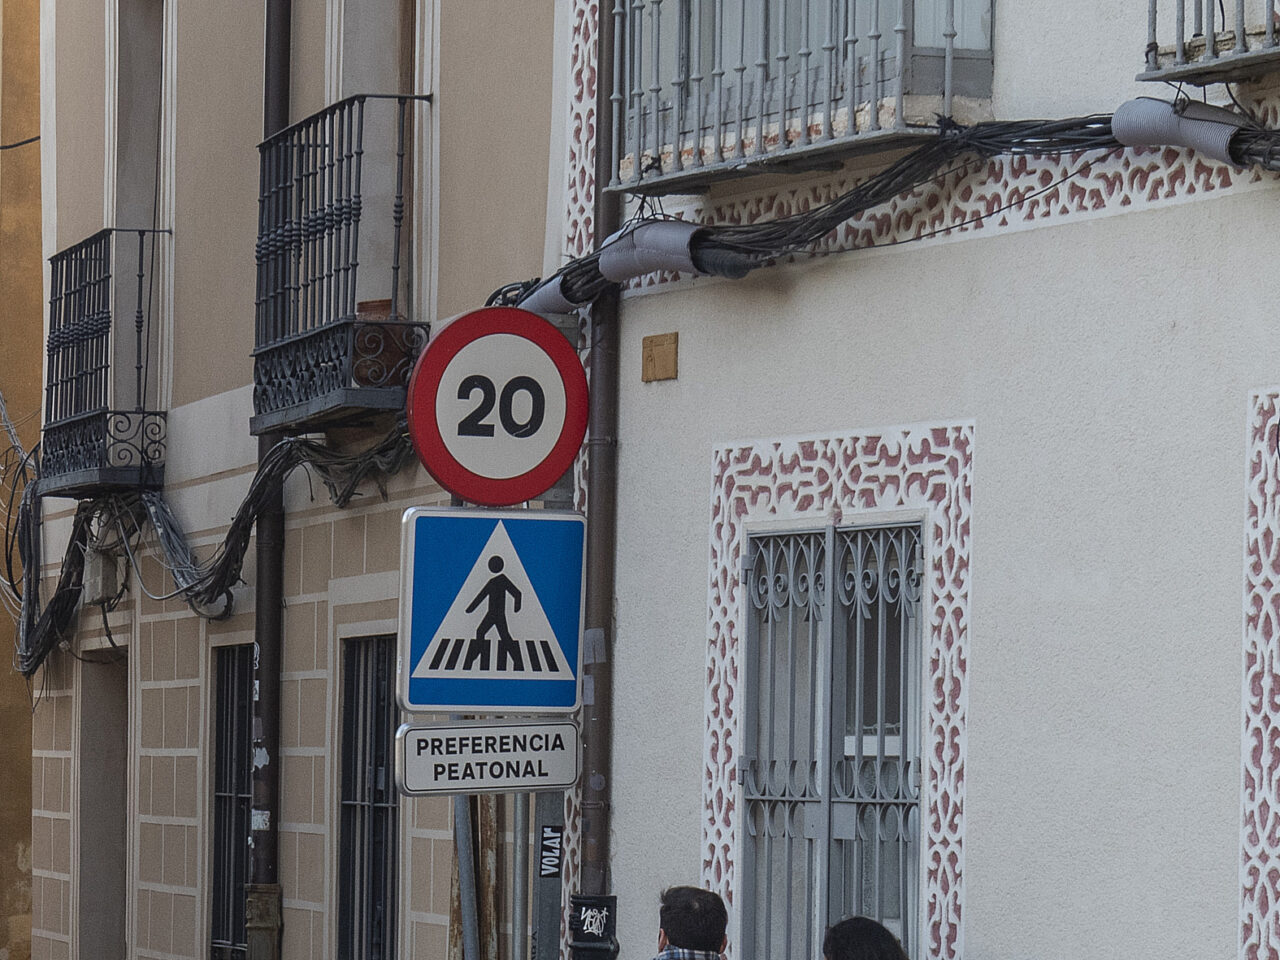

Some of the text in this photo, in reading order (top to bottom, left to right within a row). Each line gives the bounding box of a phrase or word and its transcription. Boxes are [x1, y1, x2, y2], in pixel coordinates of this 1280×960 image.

[457, 374, 546, 438] 20
[416, 732, 565, 756] PREFERENCIA
[433, 756, 549, 781] PEATONAL
